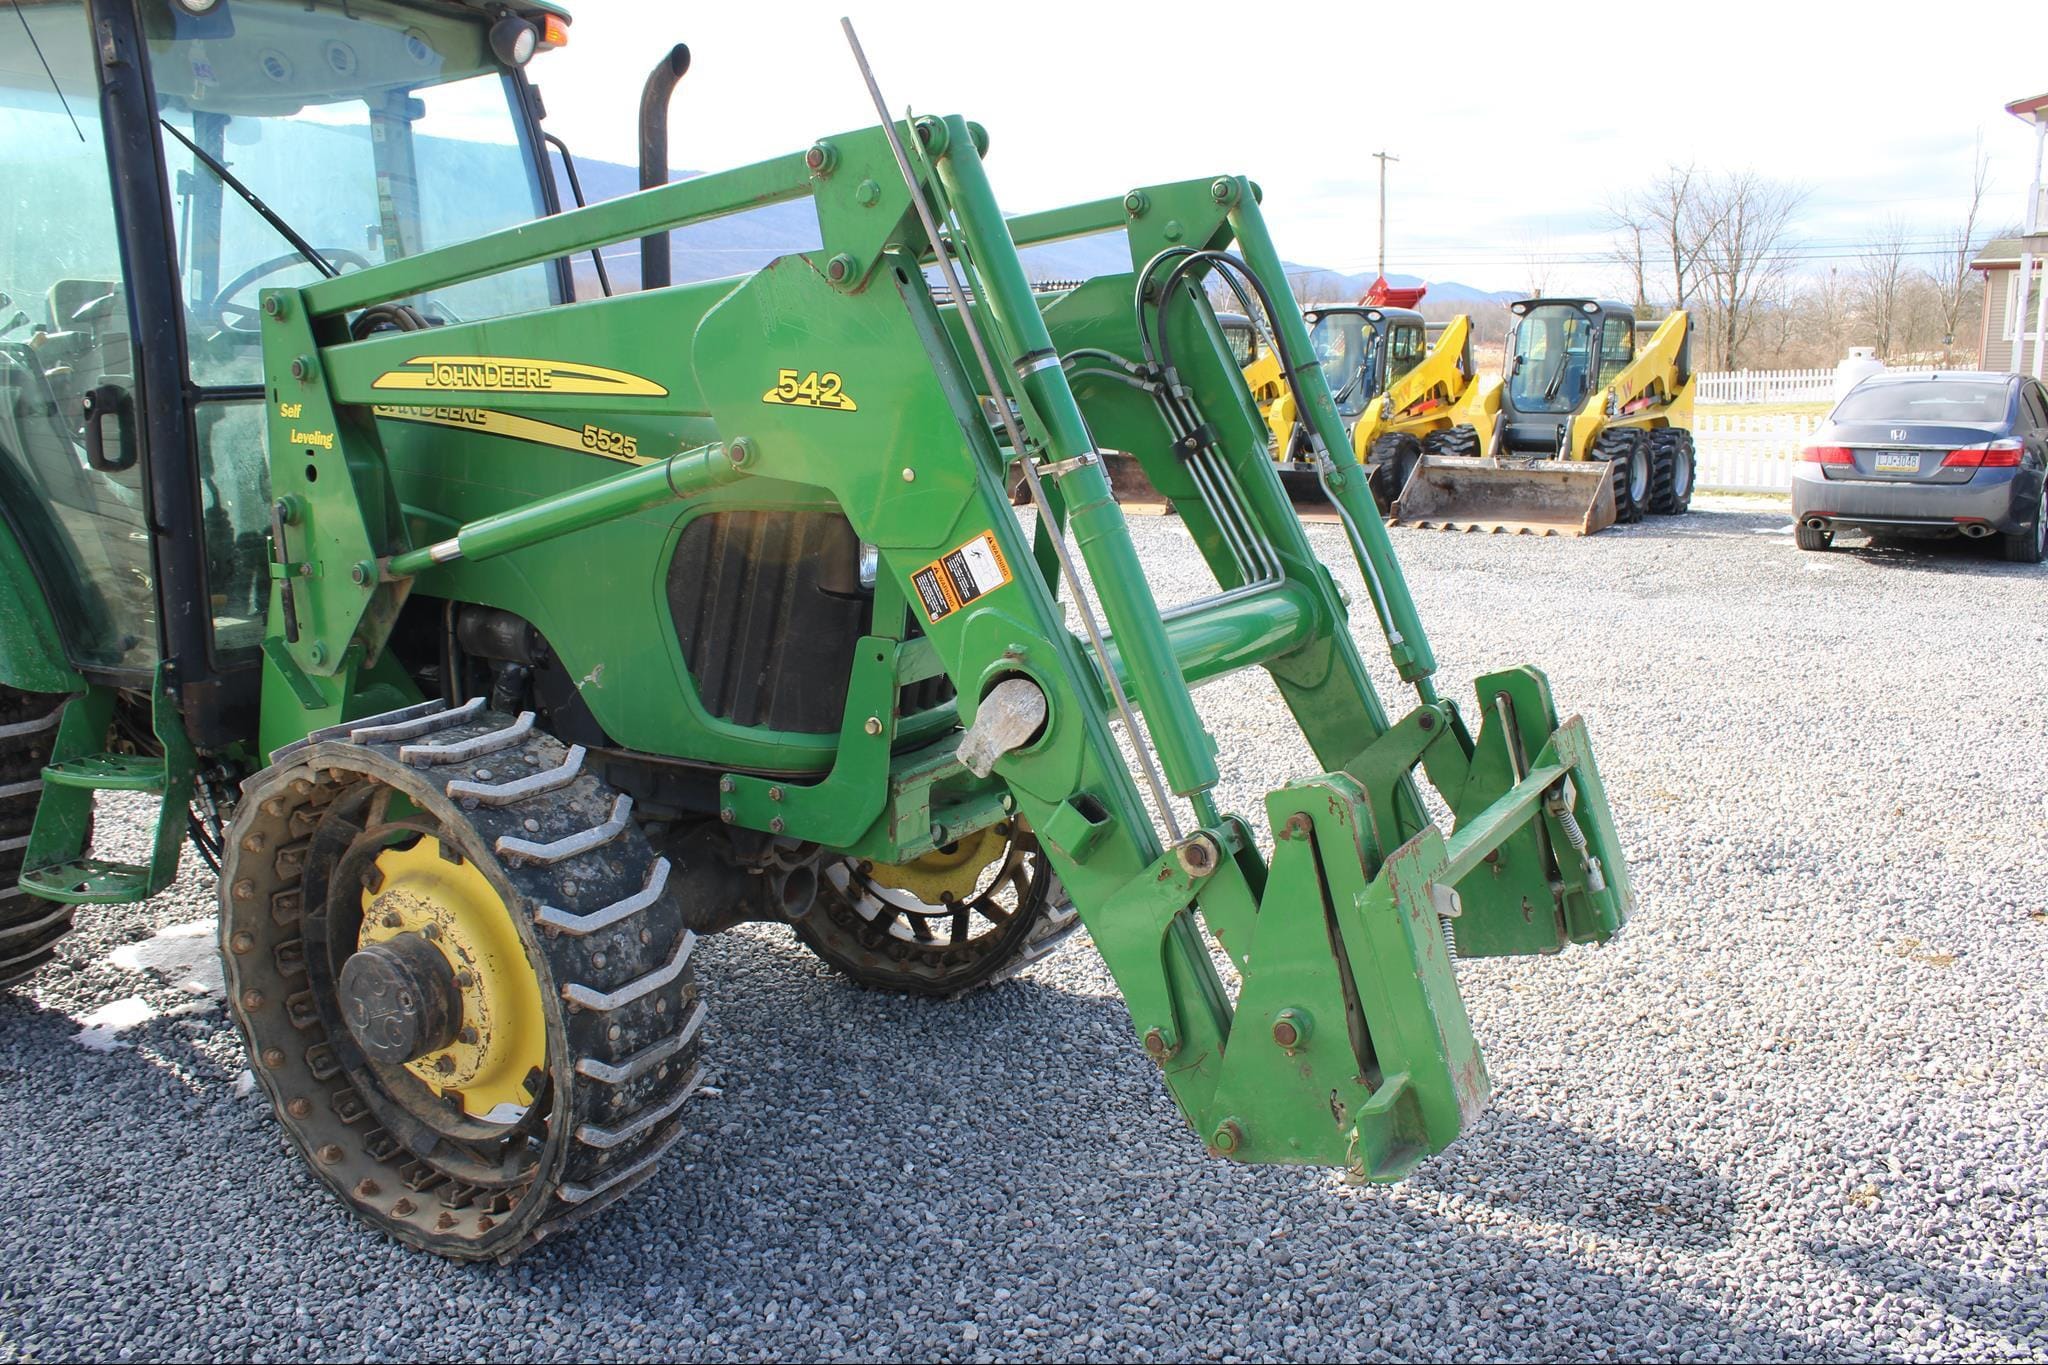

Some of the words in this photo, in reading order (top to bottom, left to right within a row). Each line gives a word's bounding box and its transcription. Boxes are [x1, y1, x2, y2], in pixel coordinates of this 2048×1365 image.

[426, 362, 482, 386] JOHN
[484, 363, 553, 388] DEERE
[778, 368, 842, 407] 542
[280, 403, 302, 418] Self
[290, 428, 334, 449] Leveling
[582, 424, 638, 458] 5525
[991, 545, 1010, 577] WARNING
[938, 575, 956, 608] WARNING
